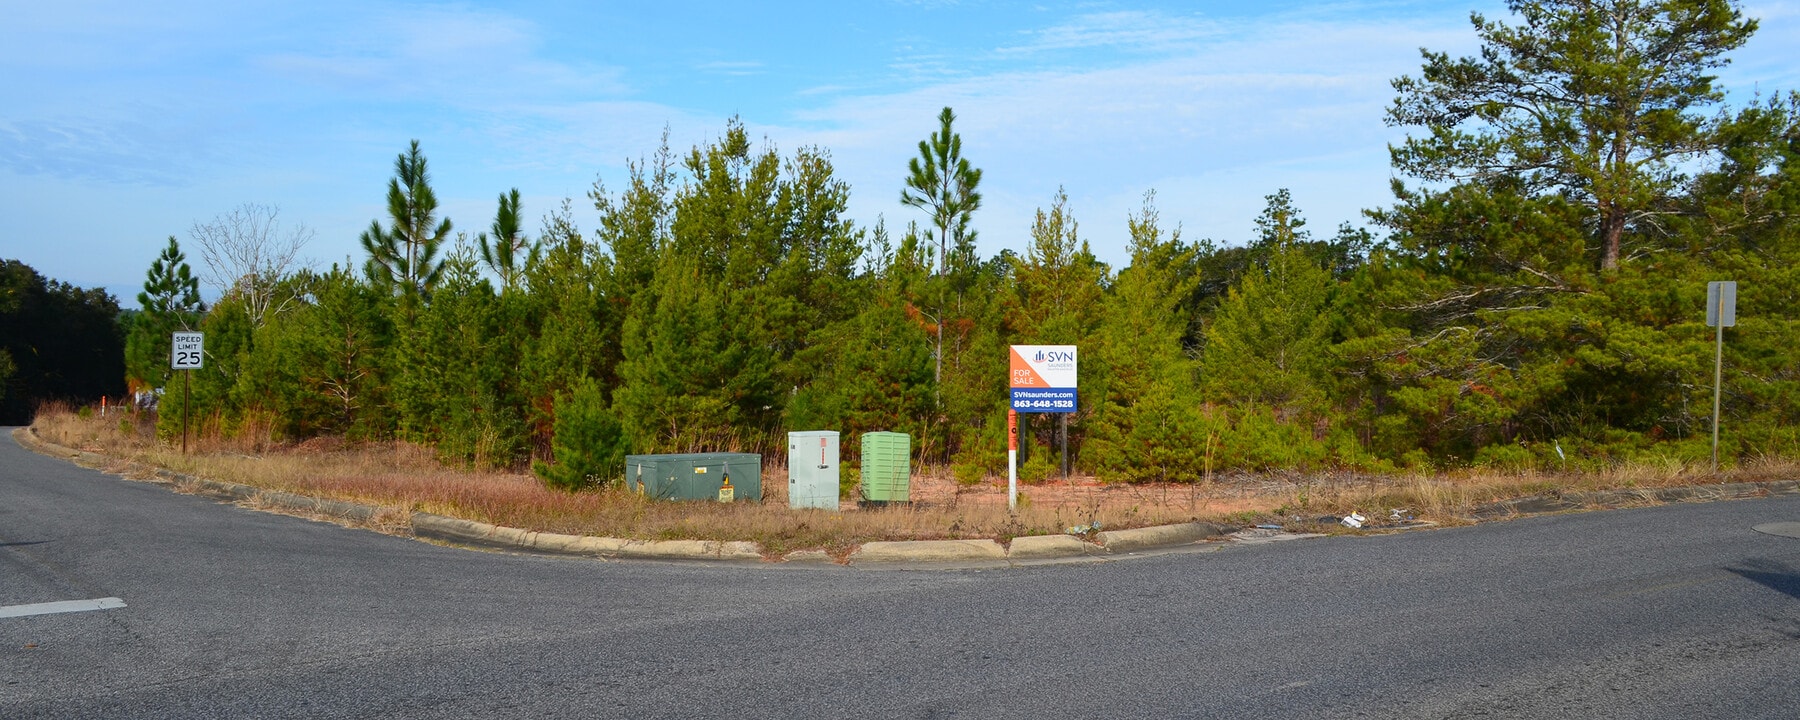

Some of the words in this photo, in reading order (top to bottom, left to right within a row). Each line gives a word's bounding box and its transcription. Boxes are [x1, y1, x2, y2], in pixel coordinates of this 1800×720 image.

[177, 352, 200, 365] 25
[1048, 351, 1073, 362] SVN
[1014, 400, 1073, 408] 863-648-1528
